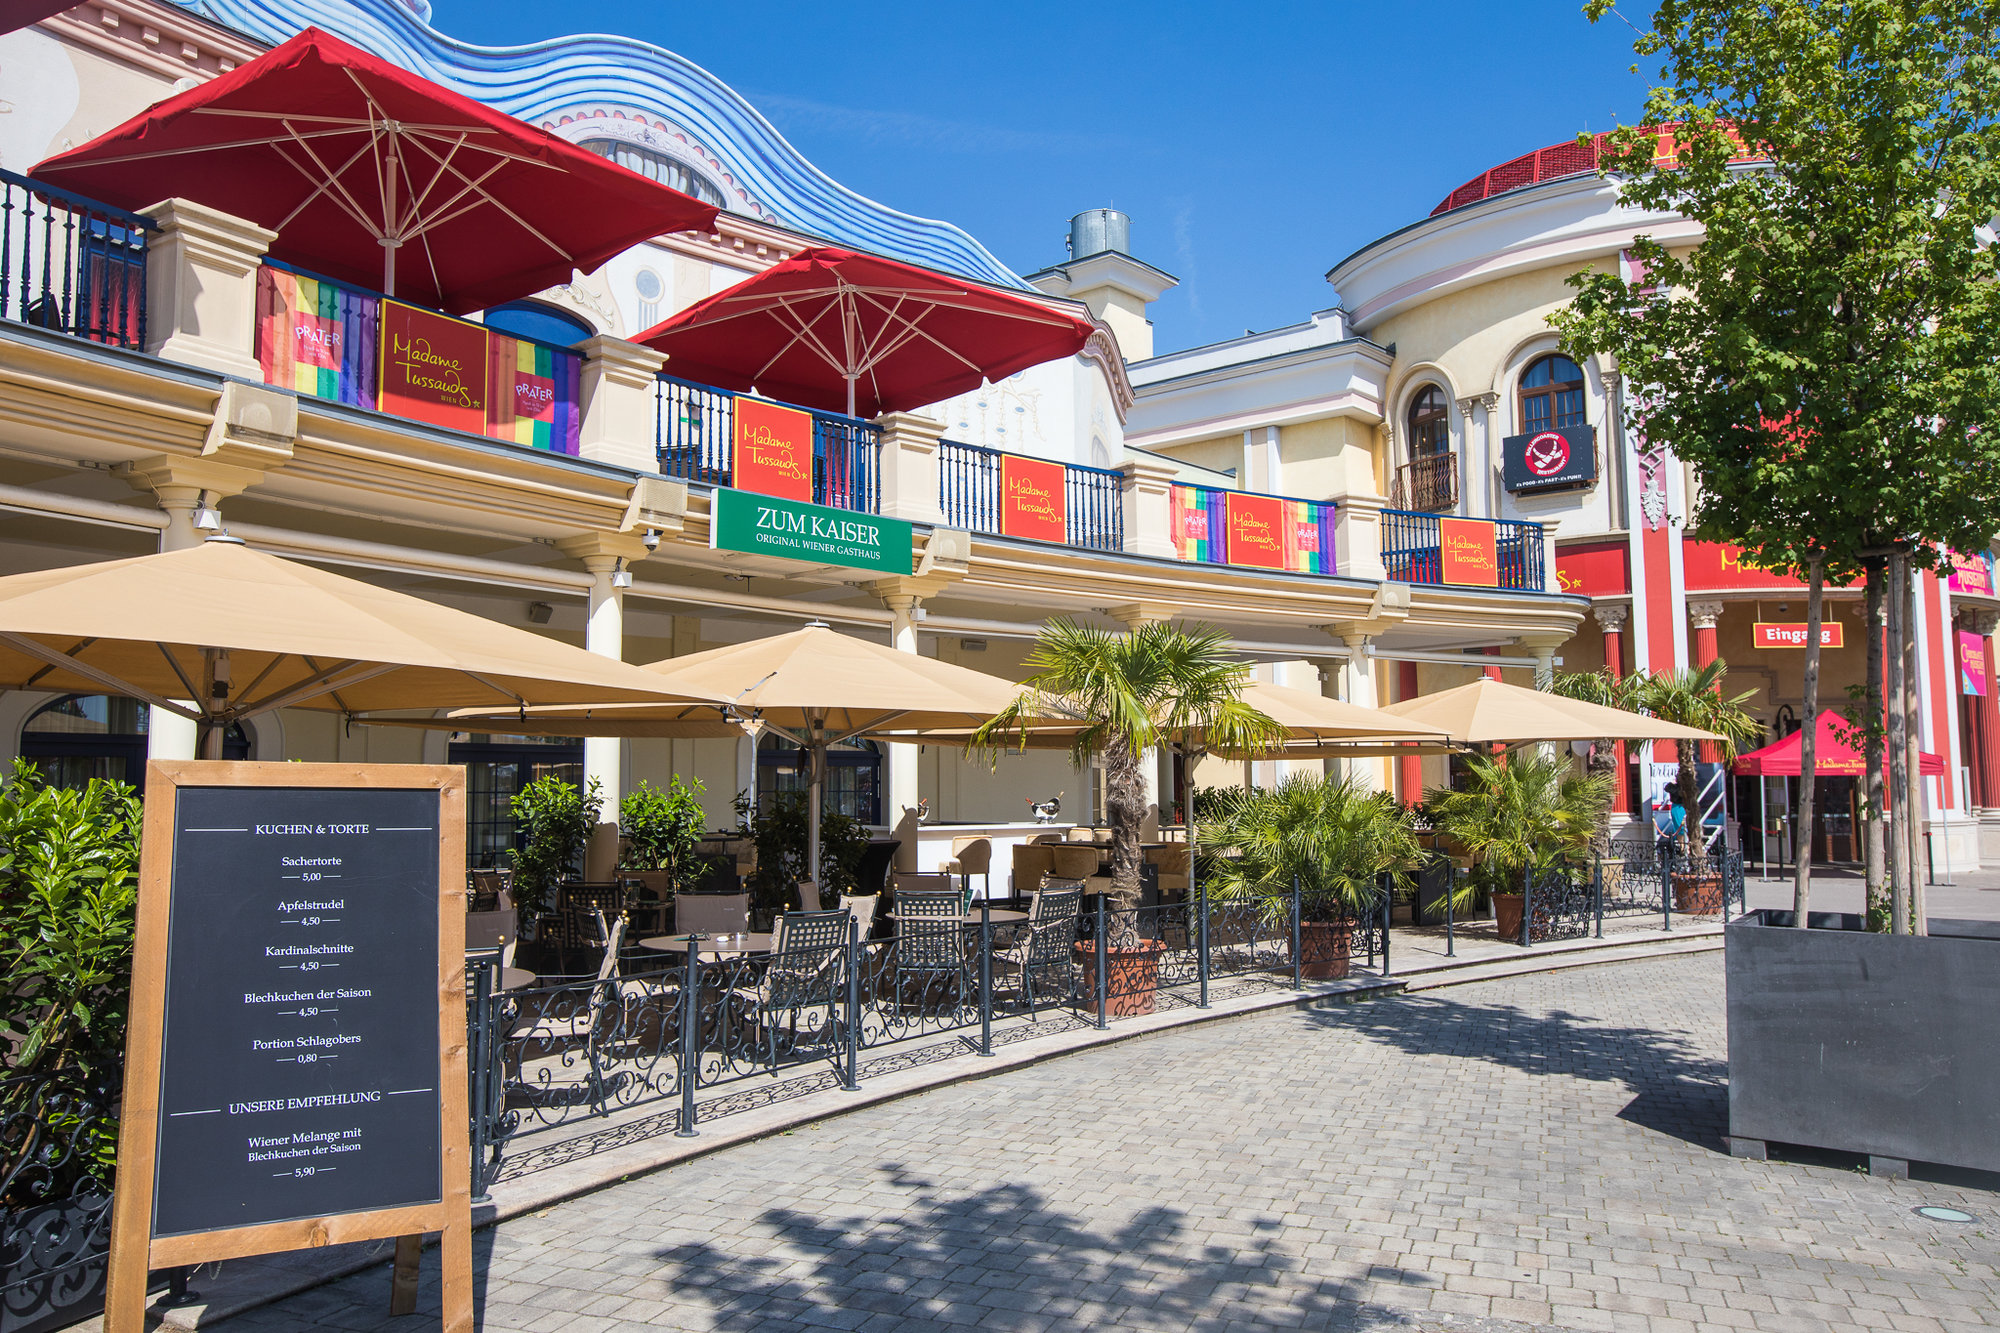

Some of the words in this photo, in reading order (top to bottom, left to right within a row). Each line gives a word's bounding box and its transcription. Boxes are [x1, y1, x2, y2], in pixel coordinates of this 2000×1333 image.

[295, 325, 341, 347] PRATER
[394, 333, 463, 370] Madame
[395, 361, 471, 408] Tussauds
[515, 383, 553, 401] PRATER
[744, 423, 794, 450] Madame
[745, 446, 801, 479] Tussauds
[1010, 476, 1051, 498] Madame
[1011, 496, 1057, 523] Tussauds
[756, 506, 806, 535] ZUM
[810, 515, 881, 547] KAISER
[1184, 515, 1207, 527] PRATER
[1233, 511, 1270, 529] Madame
[1235, 528, 1276, 551] Tussauds
[1297, 528, 1318, 539] PRATER
[756, 533, 800, 548] ORIGINAL
[802, 540, 835, 554] WIENER
[837, 545, 881, 560] GASTHAUS
[1447, 535, 1483, 550] Madame
[1449, 550, 1489, 569] Tussauds
[1765, 628, 1831, 644] Eingag
[255, 824, 313, 835] KUCHEN
[315, 824, 326, 834] &
[328, 824, 369, 834] TORTE
[281, 856, 342, 866] Sachertorte
[302, 872, 321, 882] 5,00
[277, 899, 344, 913] Apfelstrudel
[301, 916, 320, 926] 4,50
[265, 944, 354, 956] Kardinalschnitte
[300, 961, 319, 971] 4,50
[244, 991, 314, 1003] Blechkuchen
[316, 989, 335, 999] der
[336, 988, 372, 998] Saison
[298, 1007, 318, 1017] 4,50
[253, 1038, 294, 1050] Portion
[296, 1034, 362, 1048] Schlagobers
[297, 1053, 317, 1064] 0,80
[228, 1099, 285, 1115] UNSERE
[287, 1090, 381, 1110] EMPFEHLUNG
[248, 1136, 290, 1148] Wiener
[292, 1131, 340, 1143] Melange
[342, 1127, 362, 1138] mit
[248, 1149, 310, 1162] Blechkuchen
[312, 1146, 328, 1156] der
[330, 1143, 361, 1154] Saison
[294, 1166, 315, 1178] 5,90
